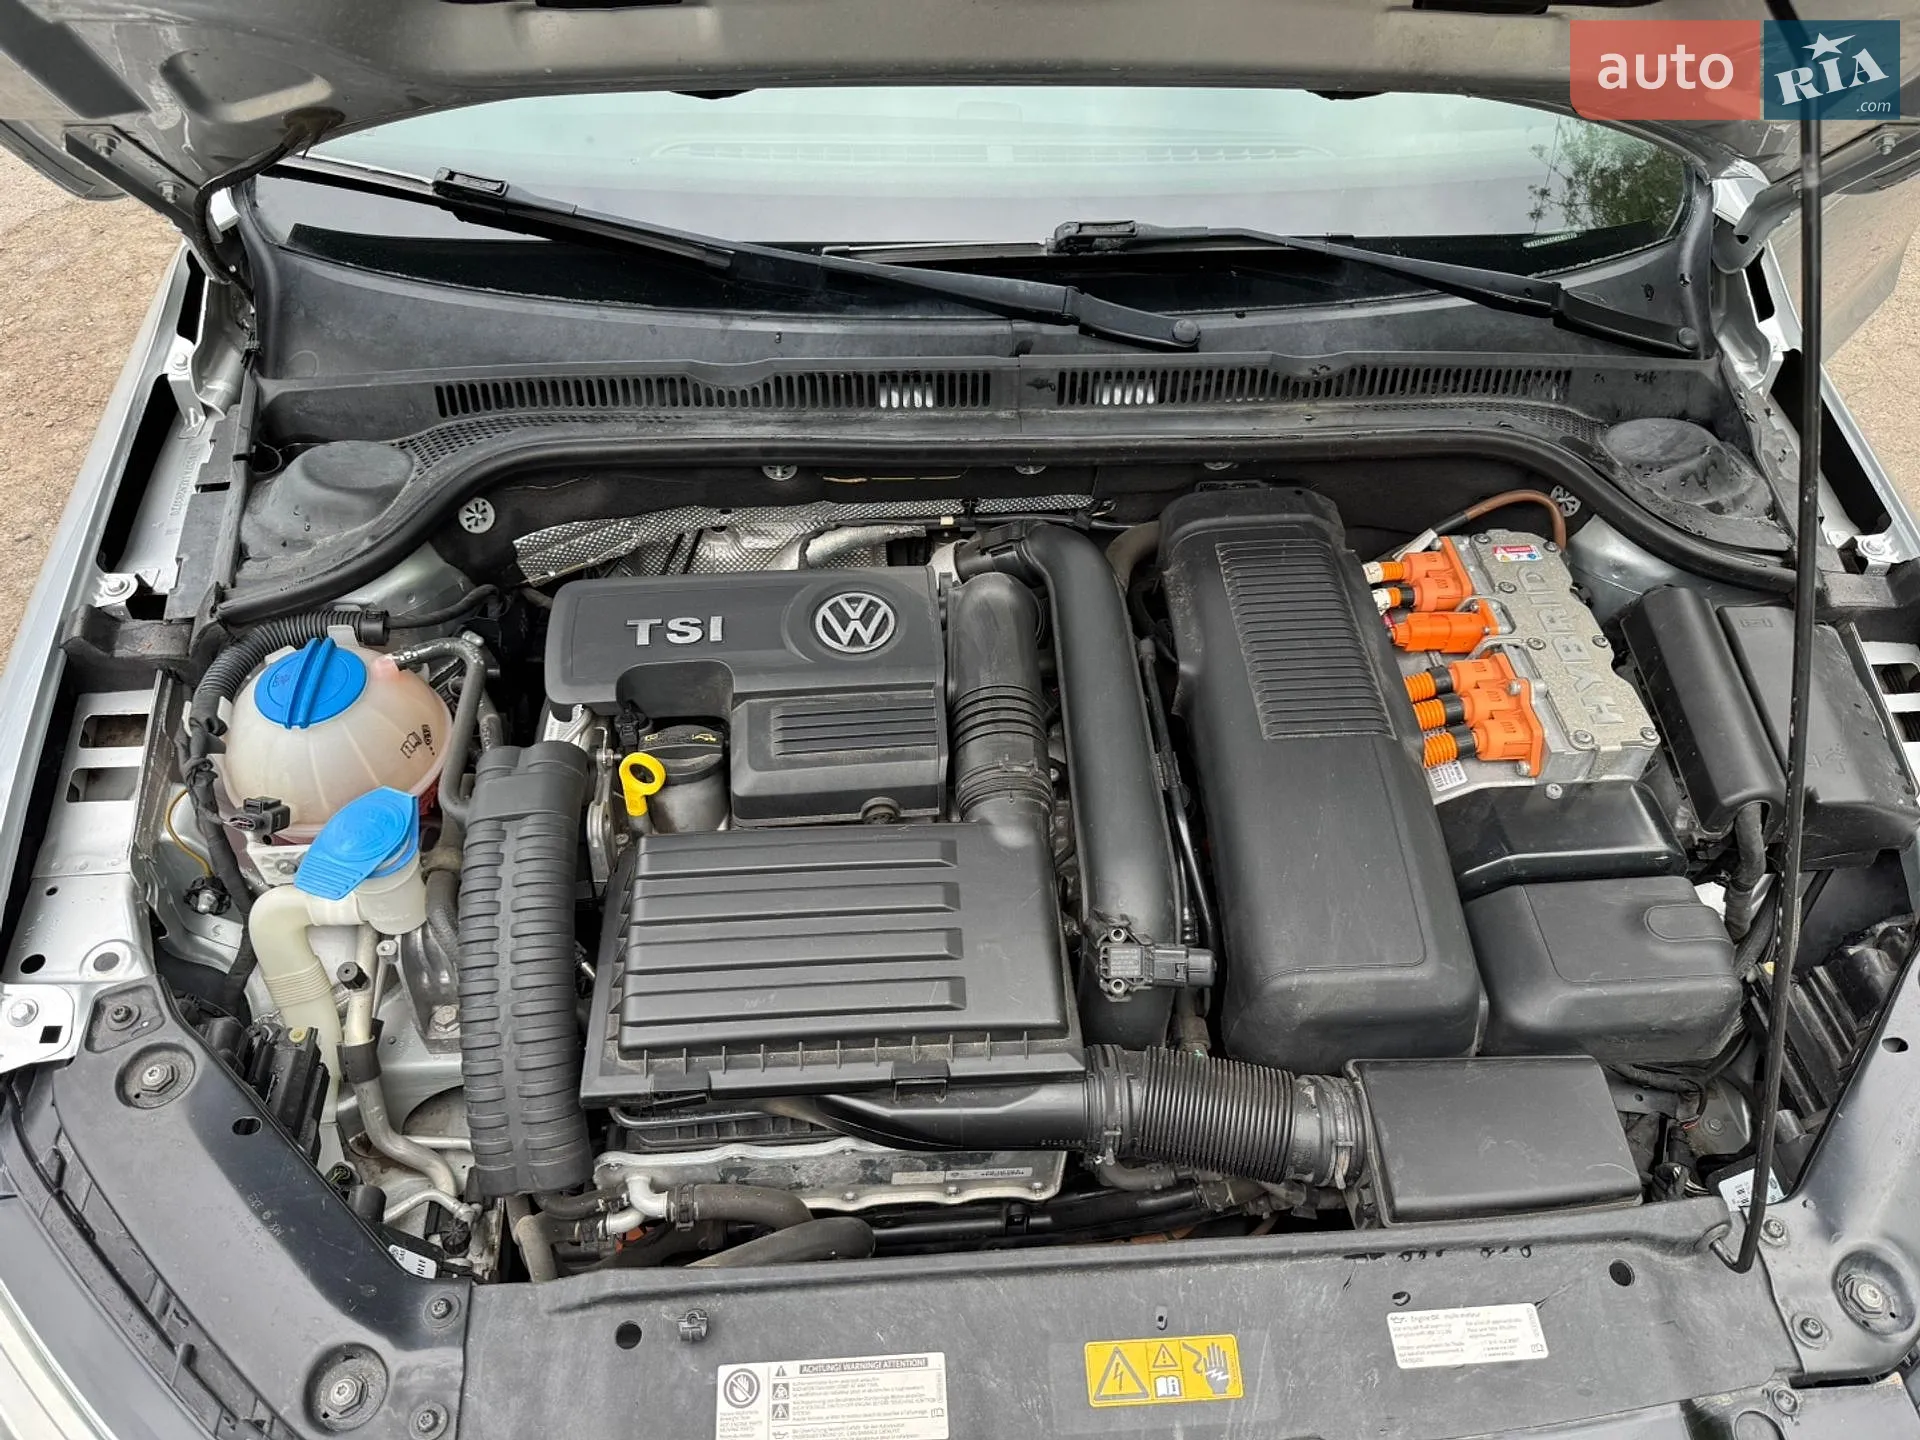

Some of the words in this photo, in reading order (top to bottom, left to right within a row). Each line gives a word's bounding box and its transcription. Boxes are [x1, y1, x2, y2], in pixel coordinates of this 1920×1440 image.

[626, 616, 724, 646] TSI
[1518, 566, 1624, 724] HYBRID
[843, 1361, 881, 1372] WARNING!
[883, 1358, 926, 1370] ATTENTION!
